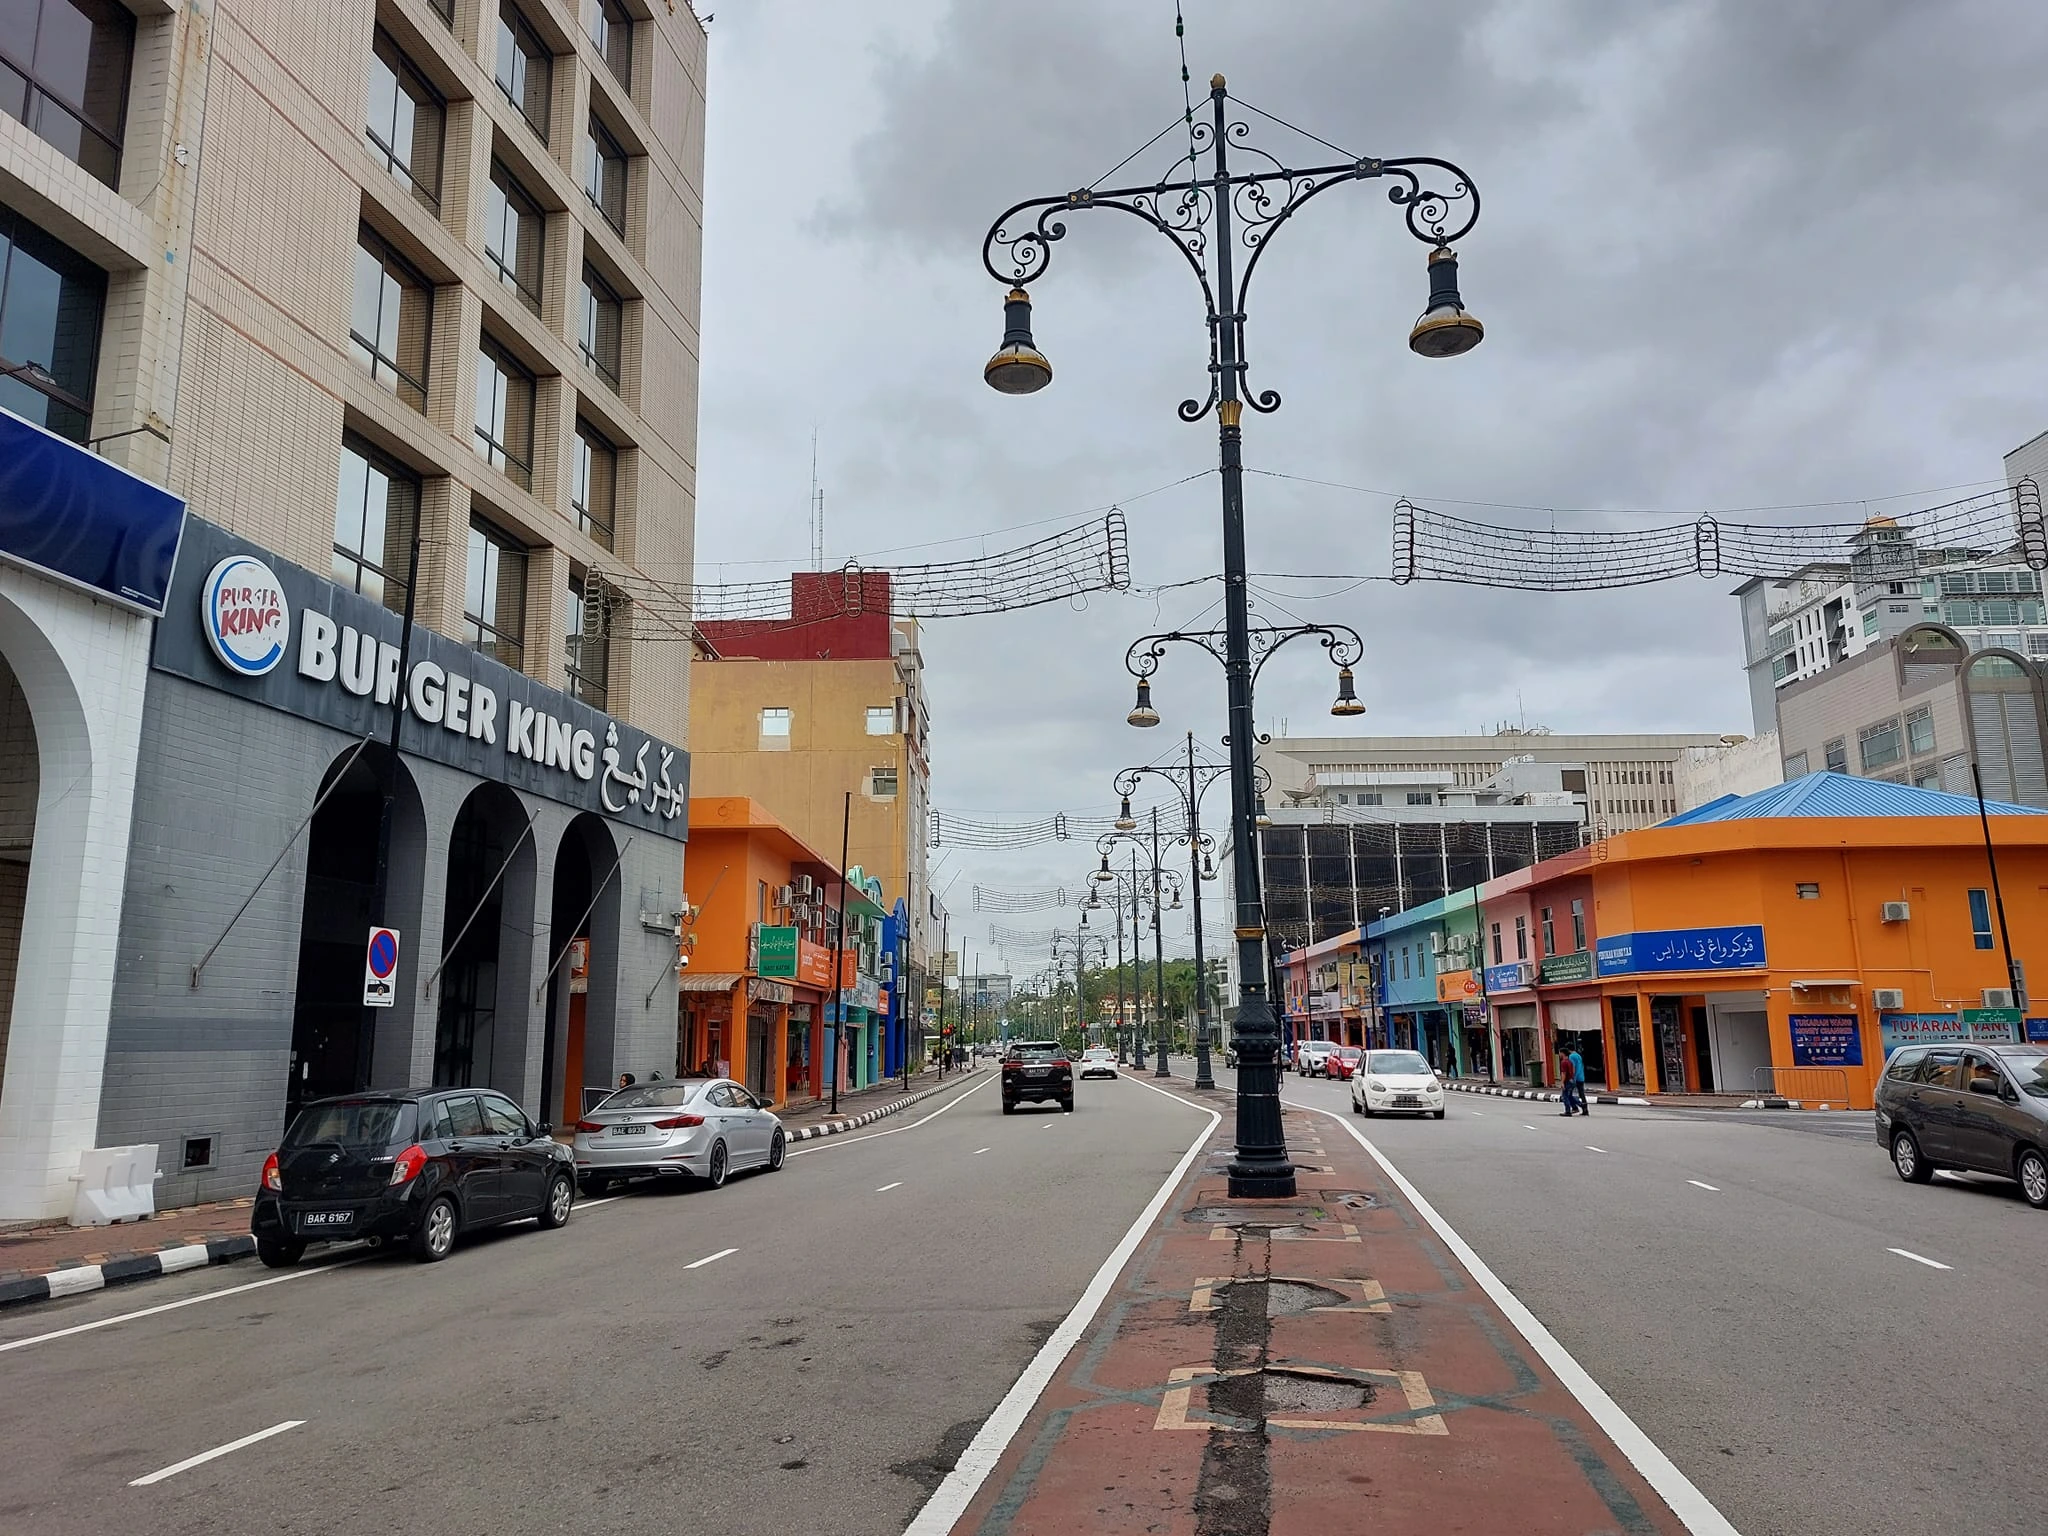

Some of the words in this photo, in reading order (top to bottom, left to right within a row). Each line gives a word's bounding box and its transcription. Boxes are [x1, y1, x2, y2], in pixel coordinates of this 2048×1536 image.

[299, 608, 497, 745] BURGER
[508, 699, 596, 780] KING
[1891, 1020, 1962, 1033] TUKARAN
[308, 1214, 326, 1224] BAR
[328, 1212, 351, 1223] 6167
